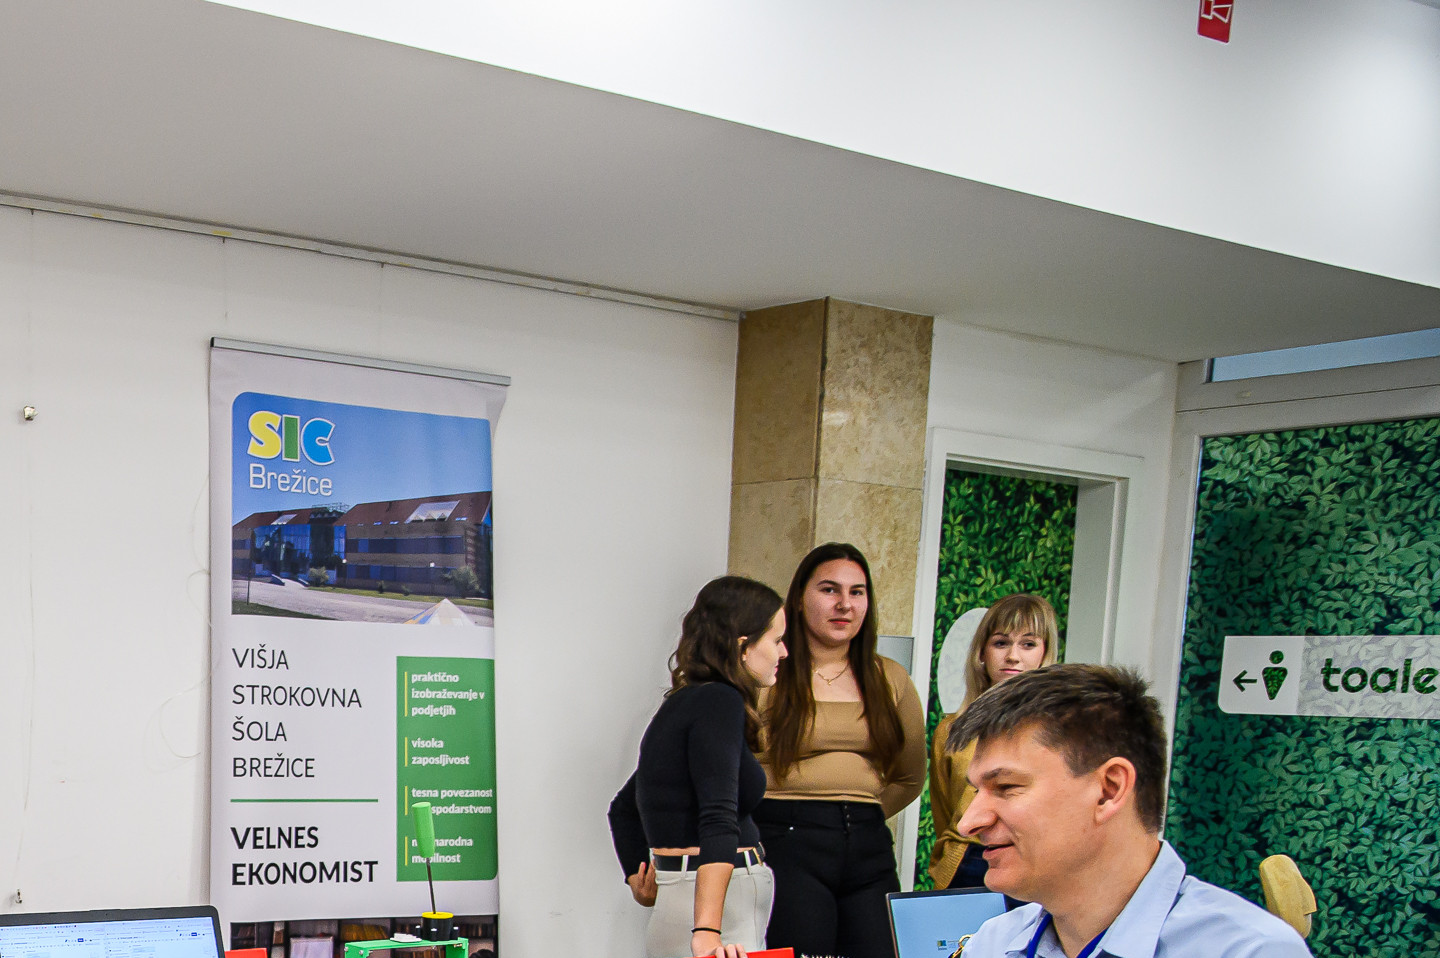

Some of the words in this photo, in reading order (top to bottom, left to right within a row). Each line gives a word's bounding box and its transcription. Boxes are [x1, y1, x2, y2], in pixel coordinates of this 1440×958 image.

[247, 410, 336, 466] SIC
[249, 463, 333, 496] Brežice
[232, 644, 289, 670] VIŠJA
[411, 671, 460, 684] praktično
[232, 684, 362, 708] STROKOVNA
[411, 687, 478, 701] izobraževanje
[479, 690, 485, 700] v
[411, 704, 456, 718] podjetjih
[232, 716, 288, 742] ŠOLA
[411, 737, 444, 749] visoka
[232, 752, 316, 779] BREŽICE
[411, 753, 470, 767] zaposljivost
[412, 787, 439, 799] tesna
[440, 786, 493, 801] povezanost
[230, 826, 319, 850] VELNES
[231, 860, 379, 886] EKONOMIST
